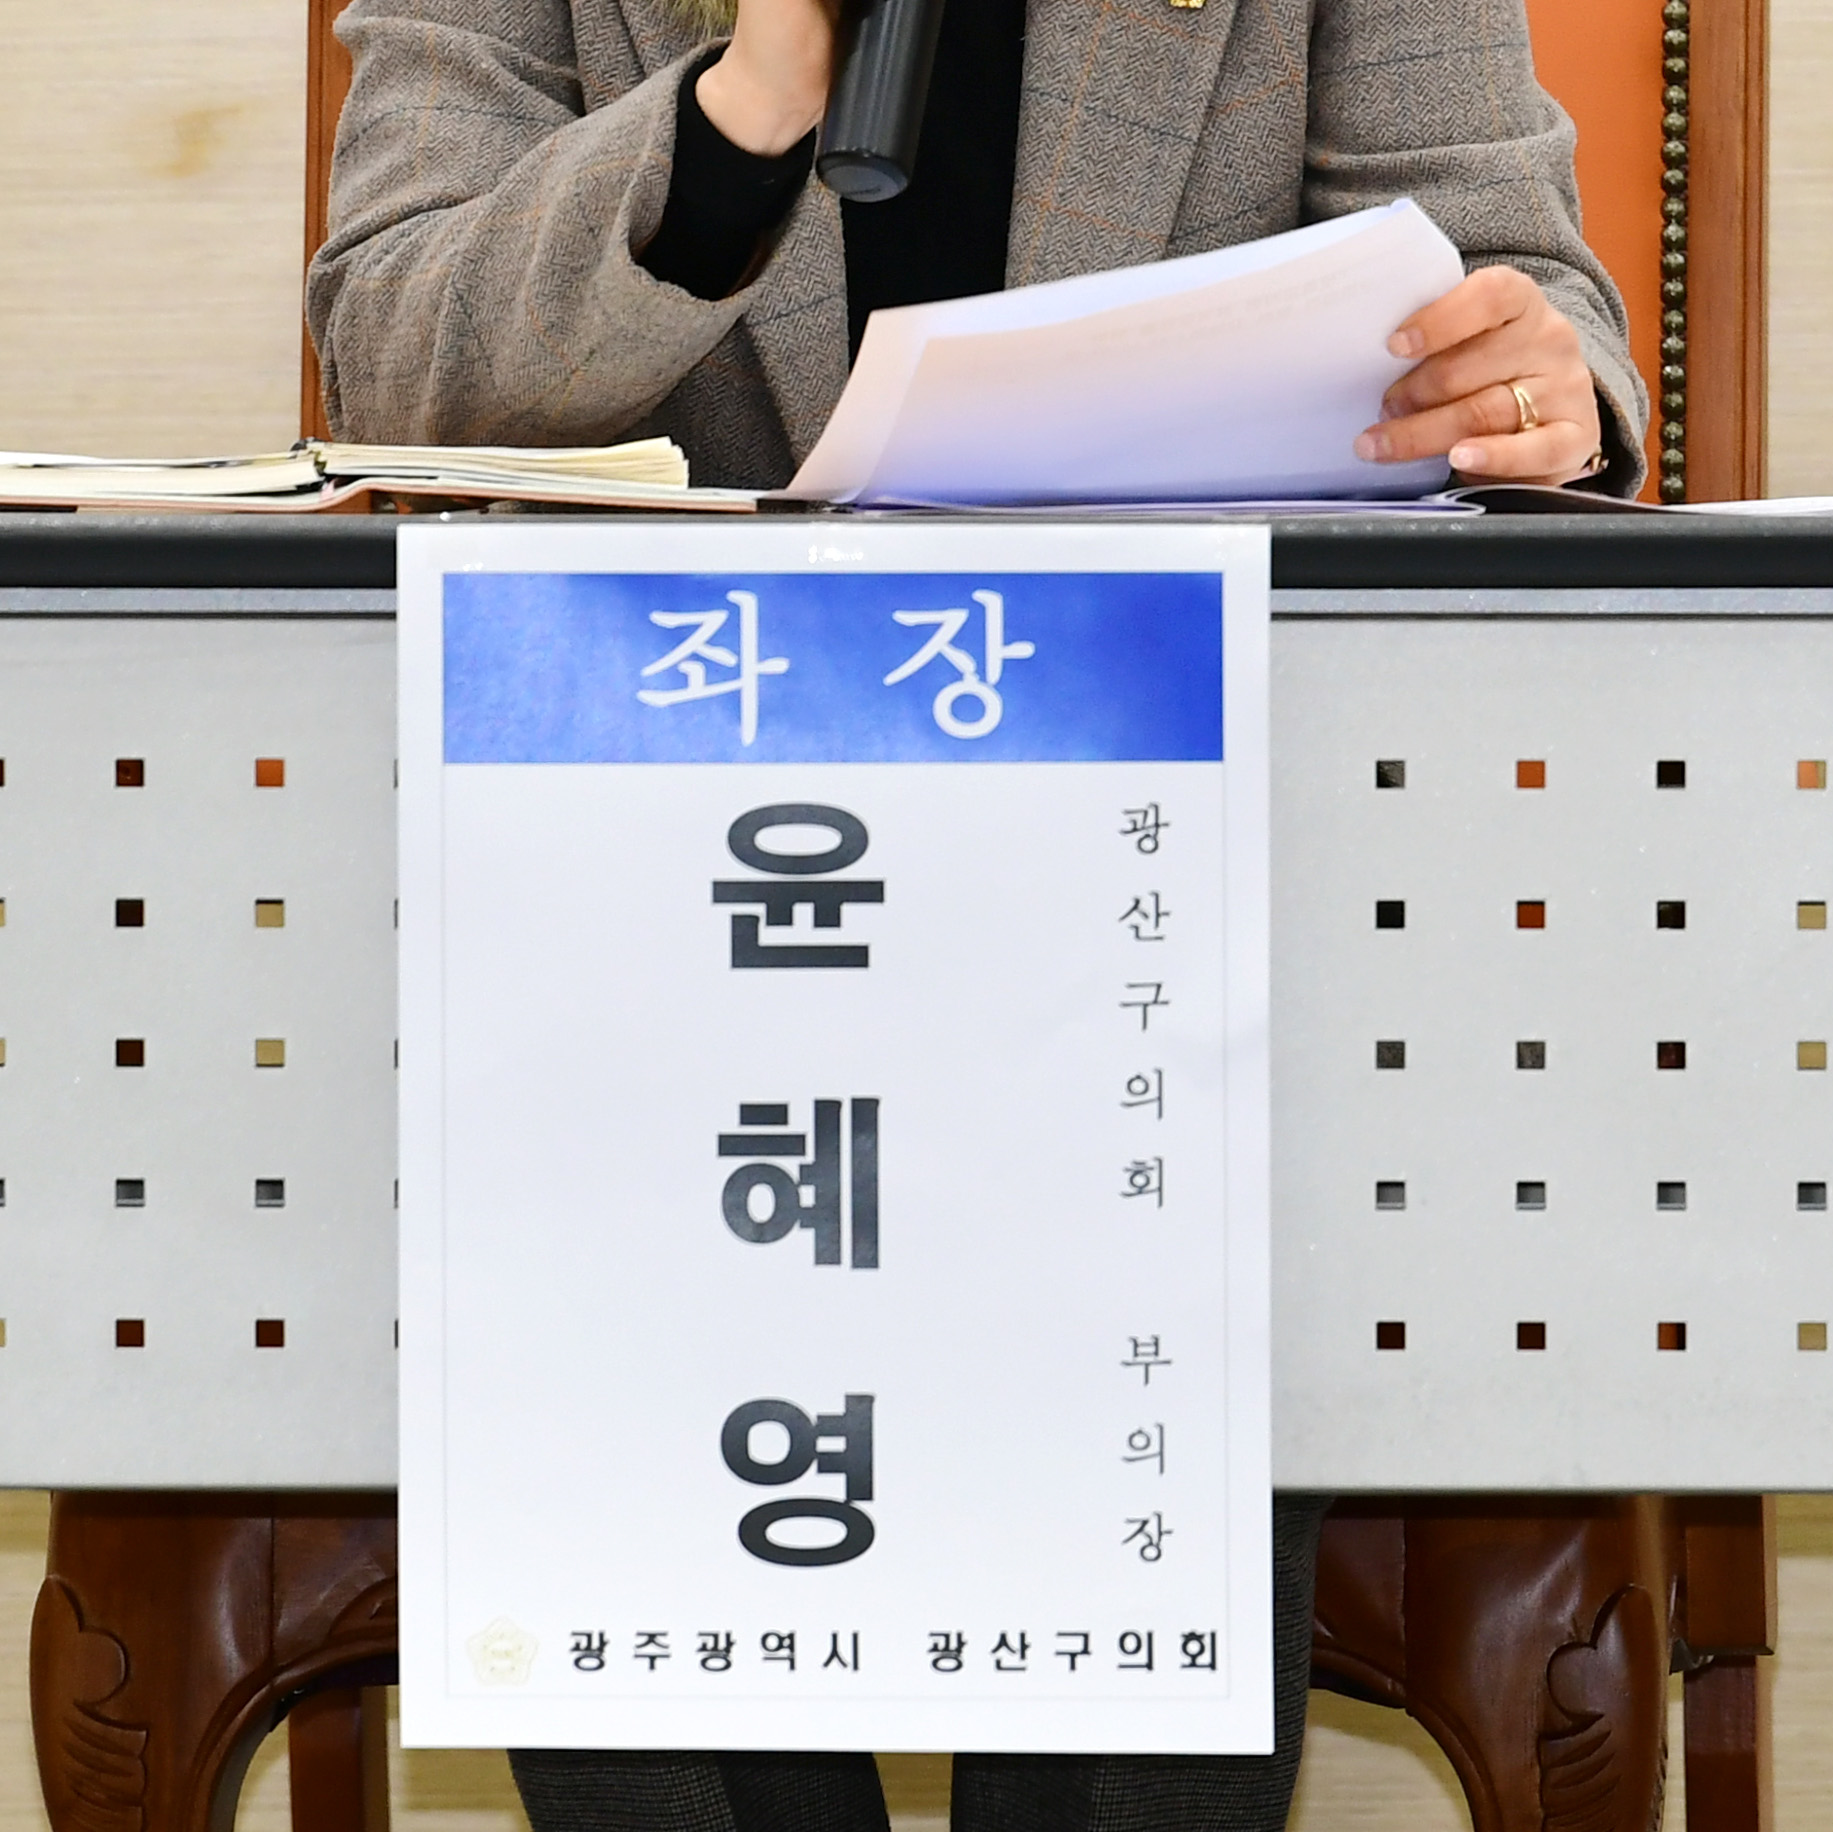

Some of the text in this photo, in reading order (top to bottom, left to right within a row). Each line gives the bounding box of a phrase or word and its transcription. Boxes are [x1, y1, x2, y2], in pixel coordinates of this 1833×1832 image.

[636, 589, 1036, 747] 좌장
[711, 802, 886, 1568] 윤혜영
[1117, 801, 1174, 1564] 광산구의회 부의장
[568, 1629, 1219, 1674] 광주광역시 광산구의회
